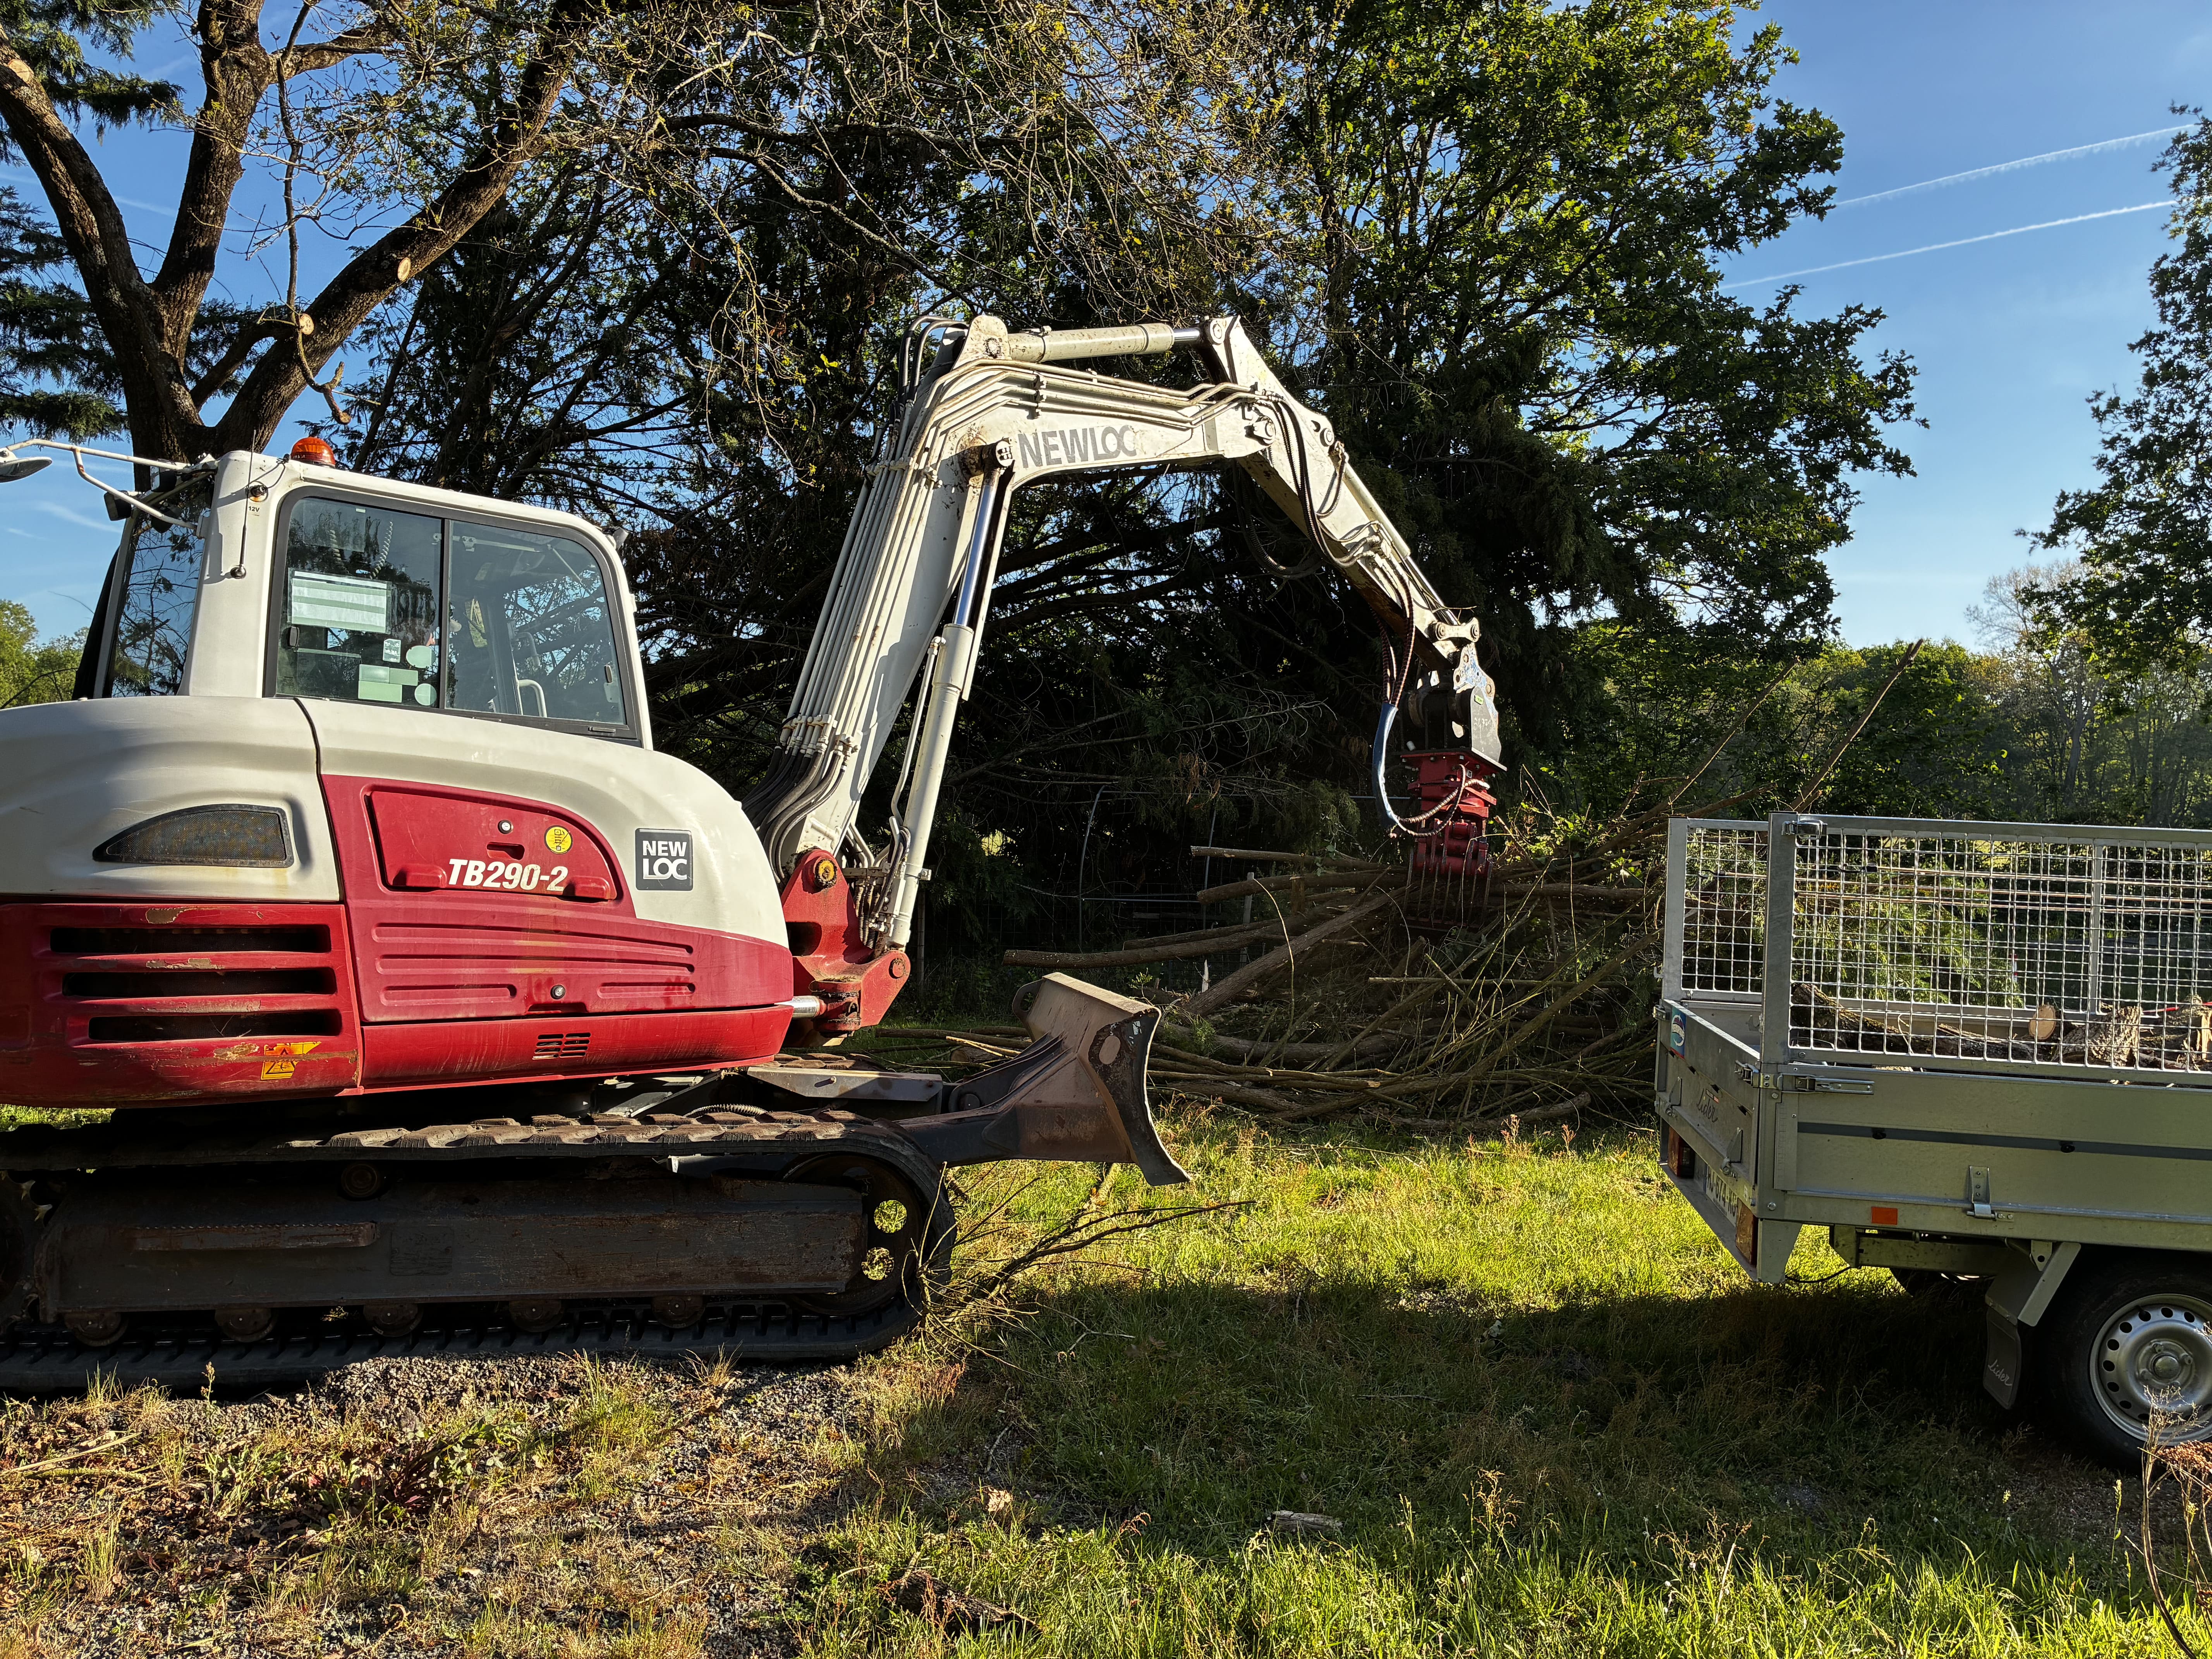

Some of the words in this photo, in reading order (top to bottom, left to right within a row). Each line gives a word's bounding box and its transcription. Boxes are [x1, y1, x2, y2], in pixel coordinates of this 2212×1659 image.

[1018, 425, 1137, 468] NEWLOC
[643, 841, 687, 857] NEW
[449, 859, 568, 891] TB290-2
[643, 858, 687, 880] LOC
[1697, 1089, 1718, 1123] Lider
